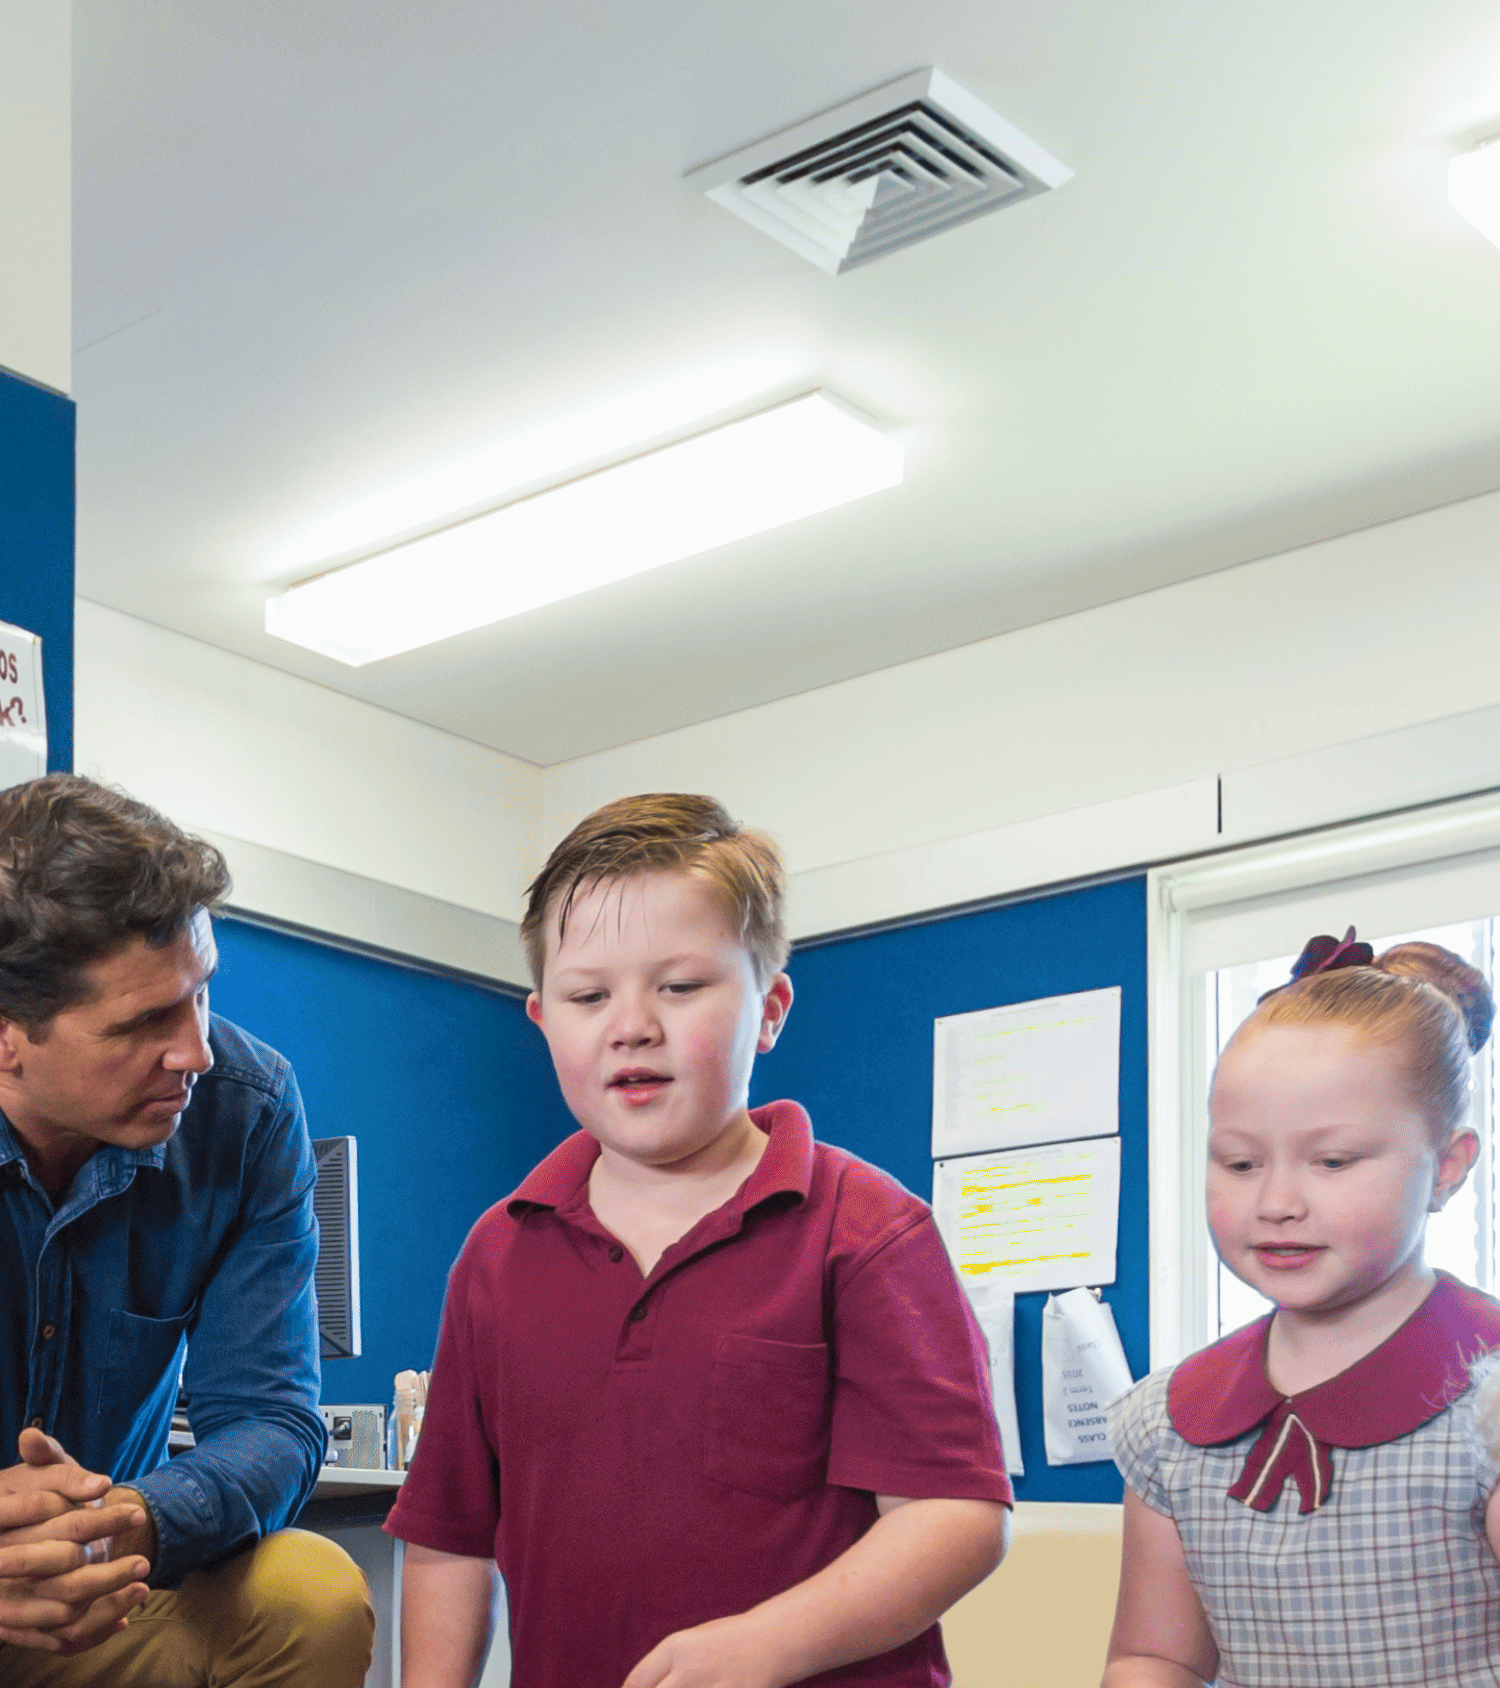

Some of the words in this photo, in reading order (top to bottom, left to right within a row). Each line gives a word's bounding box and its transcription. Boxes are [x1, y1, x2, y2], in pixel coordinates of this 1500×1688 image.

[1066, 1402, 1099, 1413] NOTES
[1067, 1416, 1108, 1429] ABSENCE
[1077, 1433, 1107, 1444] CLASS
